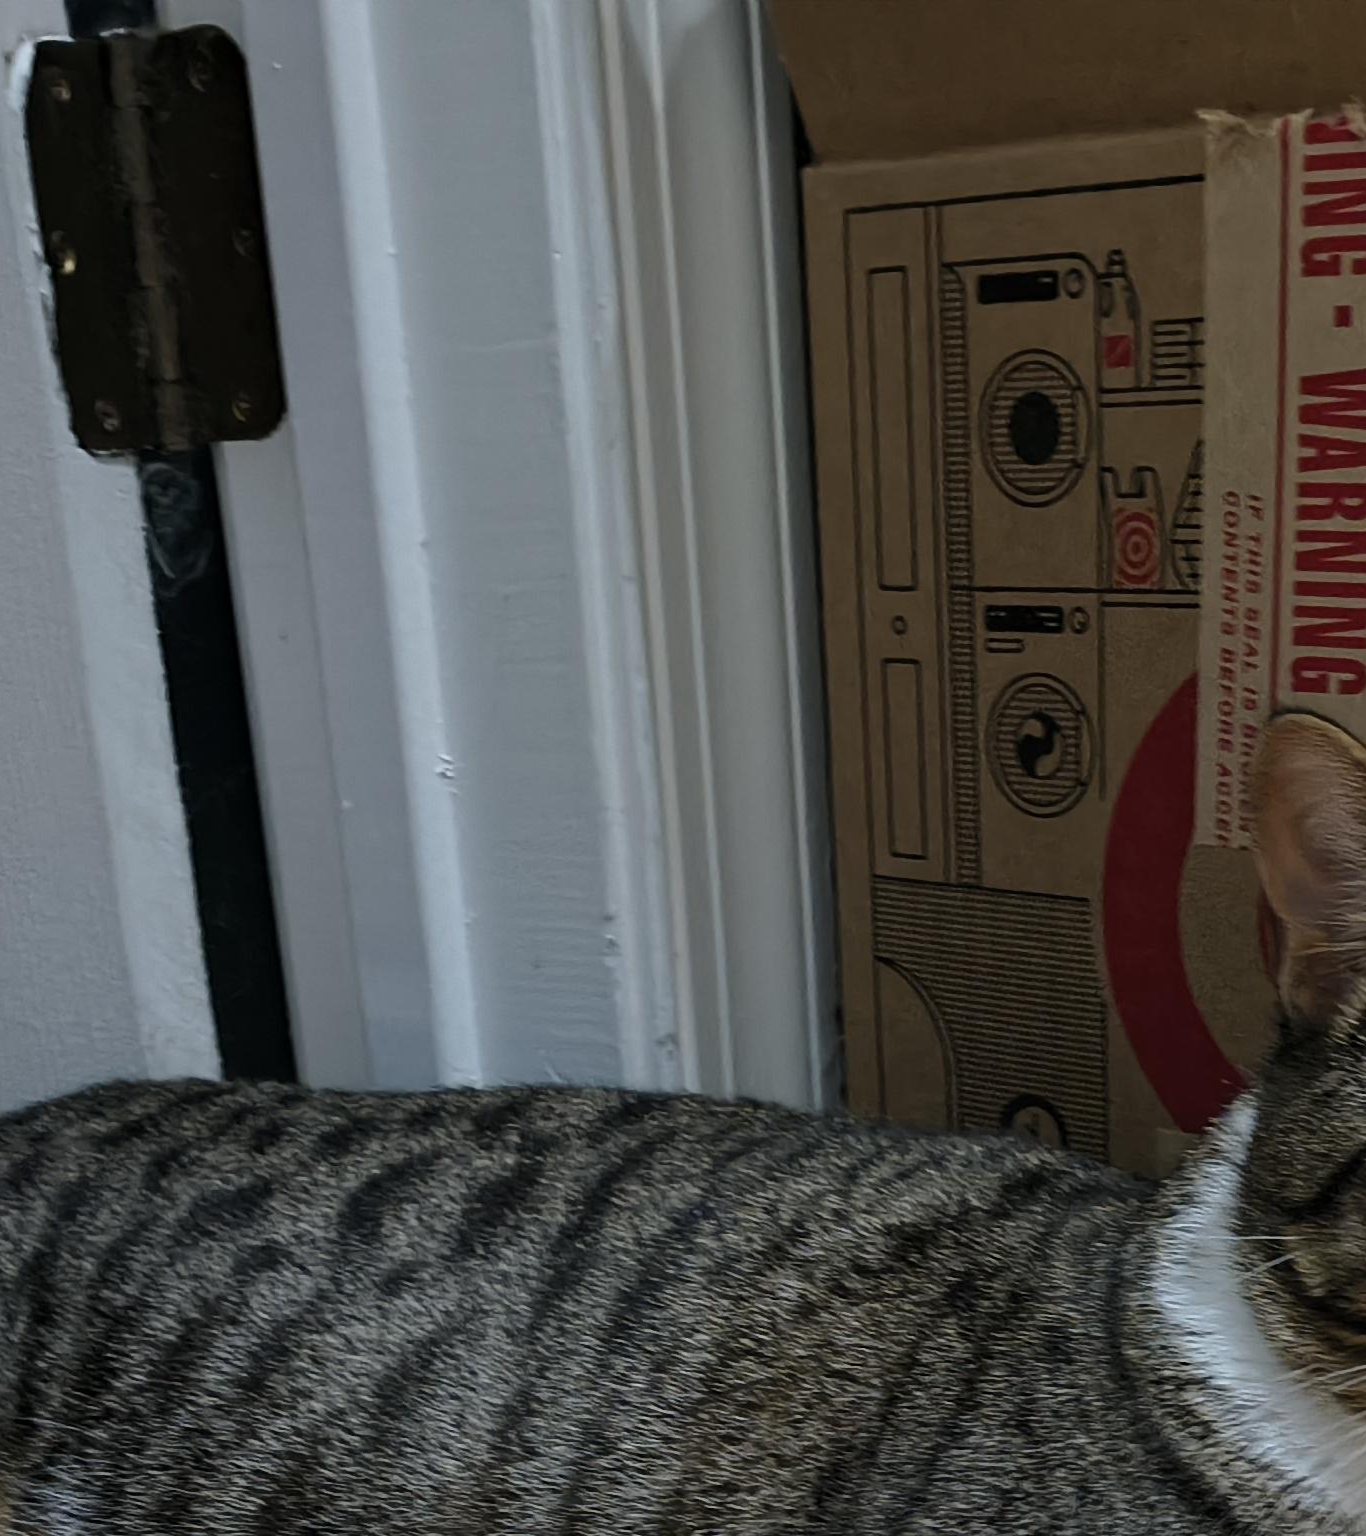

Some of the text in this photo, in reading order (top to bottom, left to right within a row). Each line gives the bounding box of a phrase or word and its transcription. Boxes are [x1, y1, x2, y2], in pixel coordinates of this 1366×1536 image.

[1246, 494, 1265, 520] IF
[1220, 490, 1241, 637] CONTENTS
[1244, 534, 1264, 592] THIS
[1241, 607, 1262, 672] SEAL
[1217, 647, 1237, 753] BEFORE
